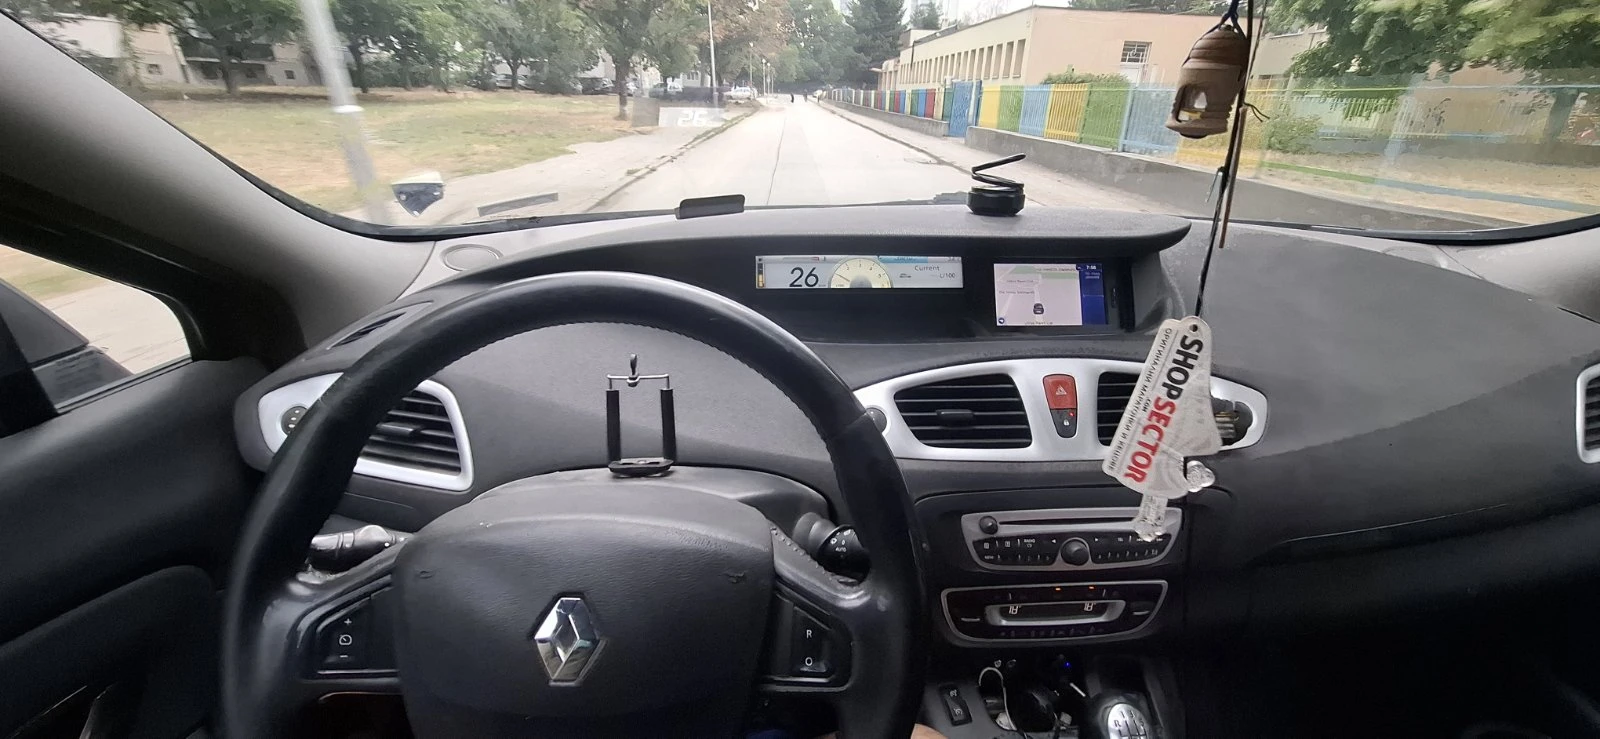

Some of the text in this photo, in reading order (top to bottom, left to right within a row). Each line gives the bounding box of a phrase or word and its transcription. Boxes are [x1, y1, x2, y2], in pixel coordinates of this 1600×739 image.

[677, 109, 708, 127] 26
[789, 266, 820, 288] 26
[915, 264, 941, 272] Current
[1144, 327, 1173, 383] ОРИГИНАЛНИ
[1124, 334, 1204, 484] SHOPSECTOR
[806, 629, 813, 639] R
[1113, 720, 1122, 728] R
